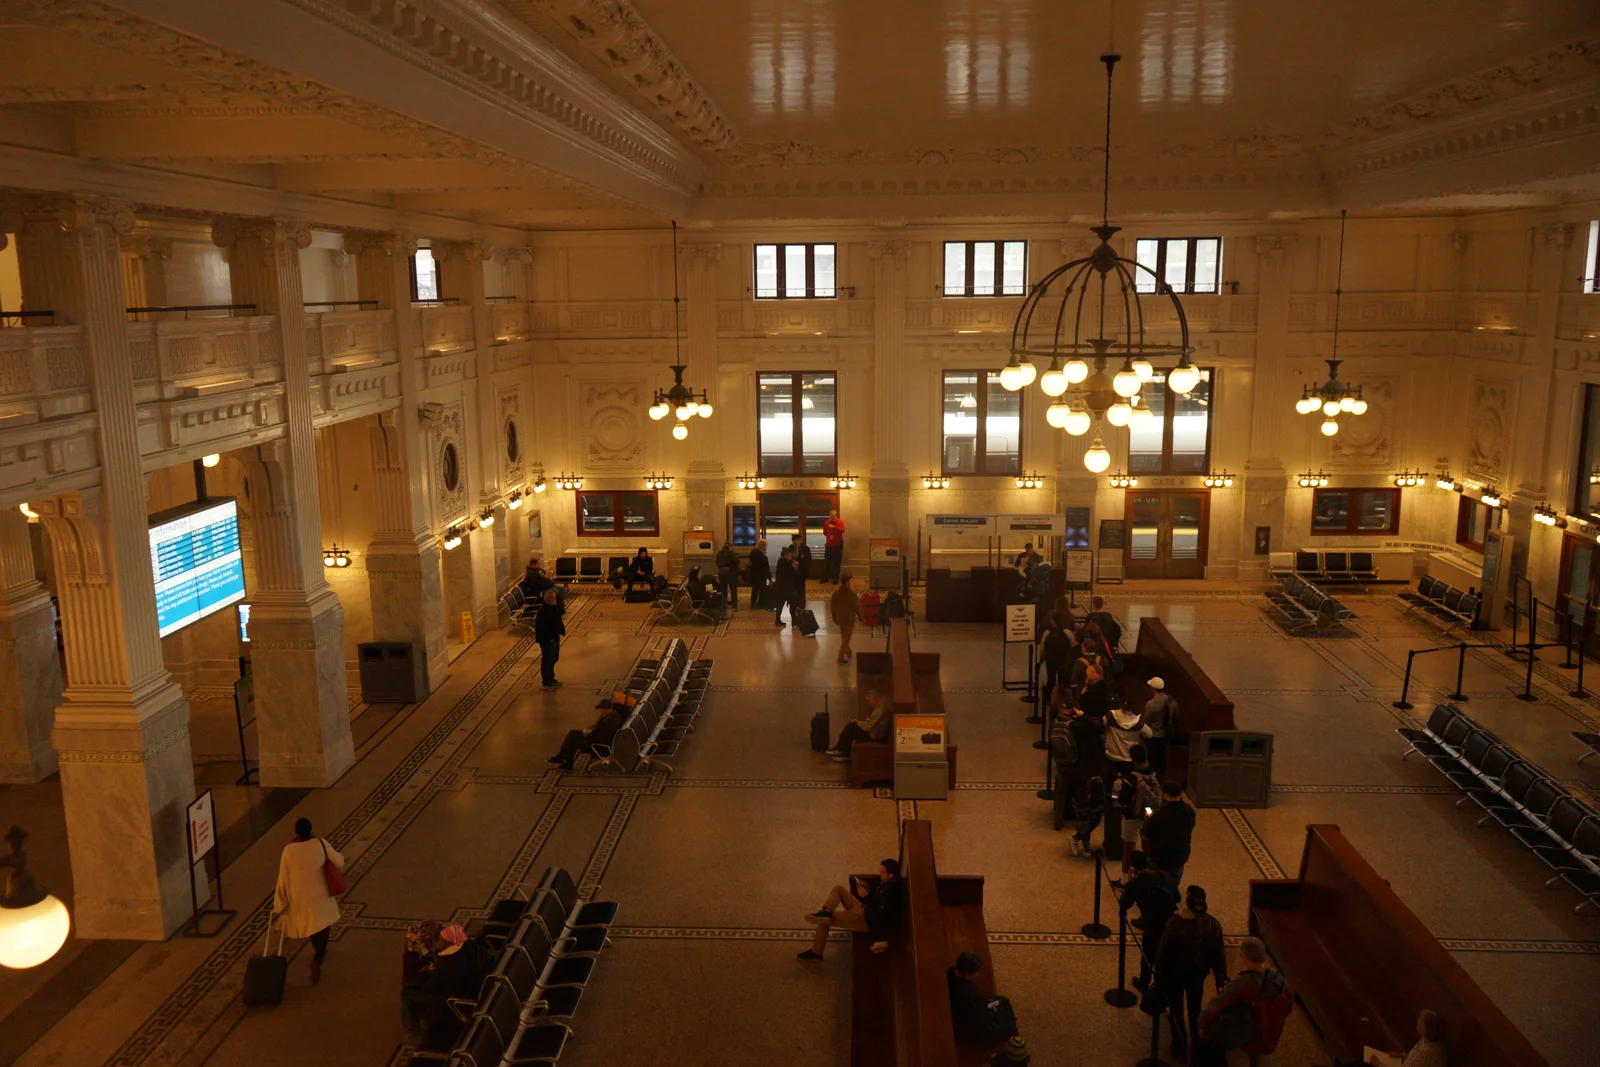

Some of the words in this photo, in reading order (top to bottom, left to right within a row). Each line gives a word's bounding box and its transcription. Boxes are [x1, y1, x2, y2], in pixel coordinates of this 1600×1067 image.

[782, 480, 804, 488] GATE
[1152, 478, 1174, 486] GATE
[155, 520, 187, 537] Information
